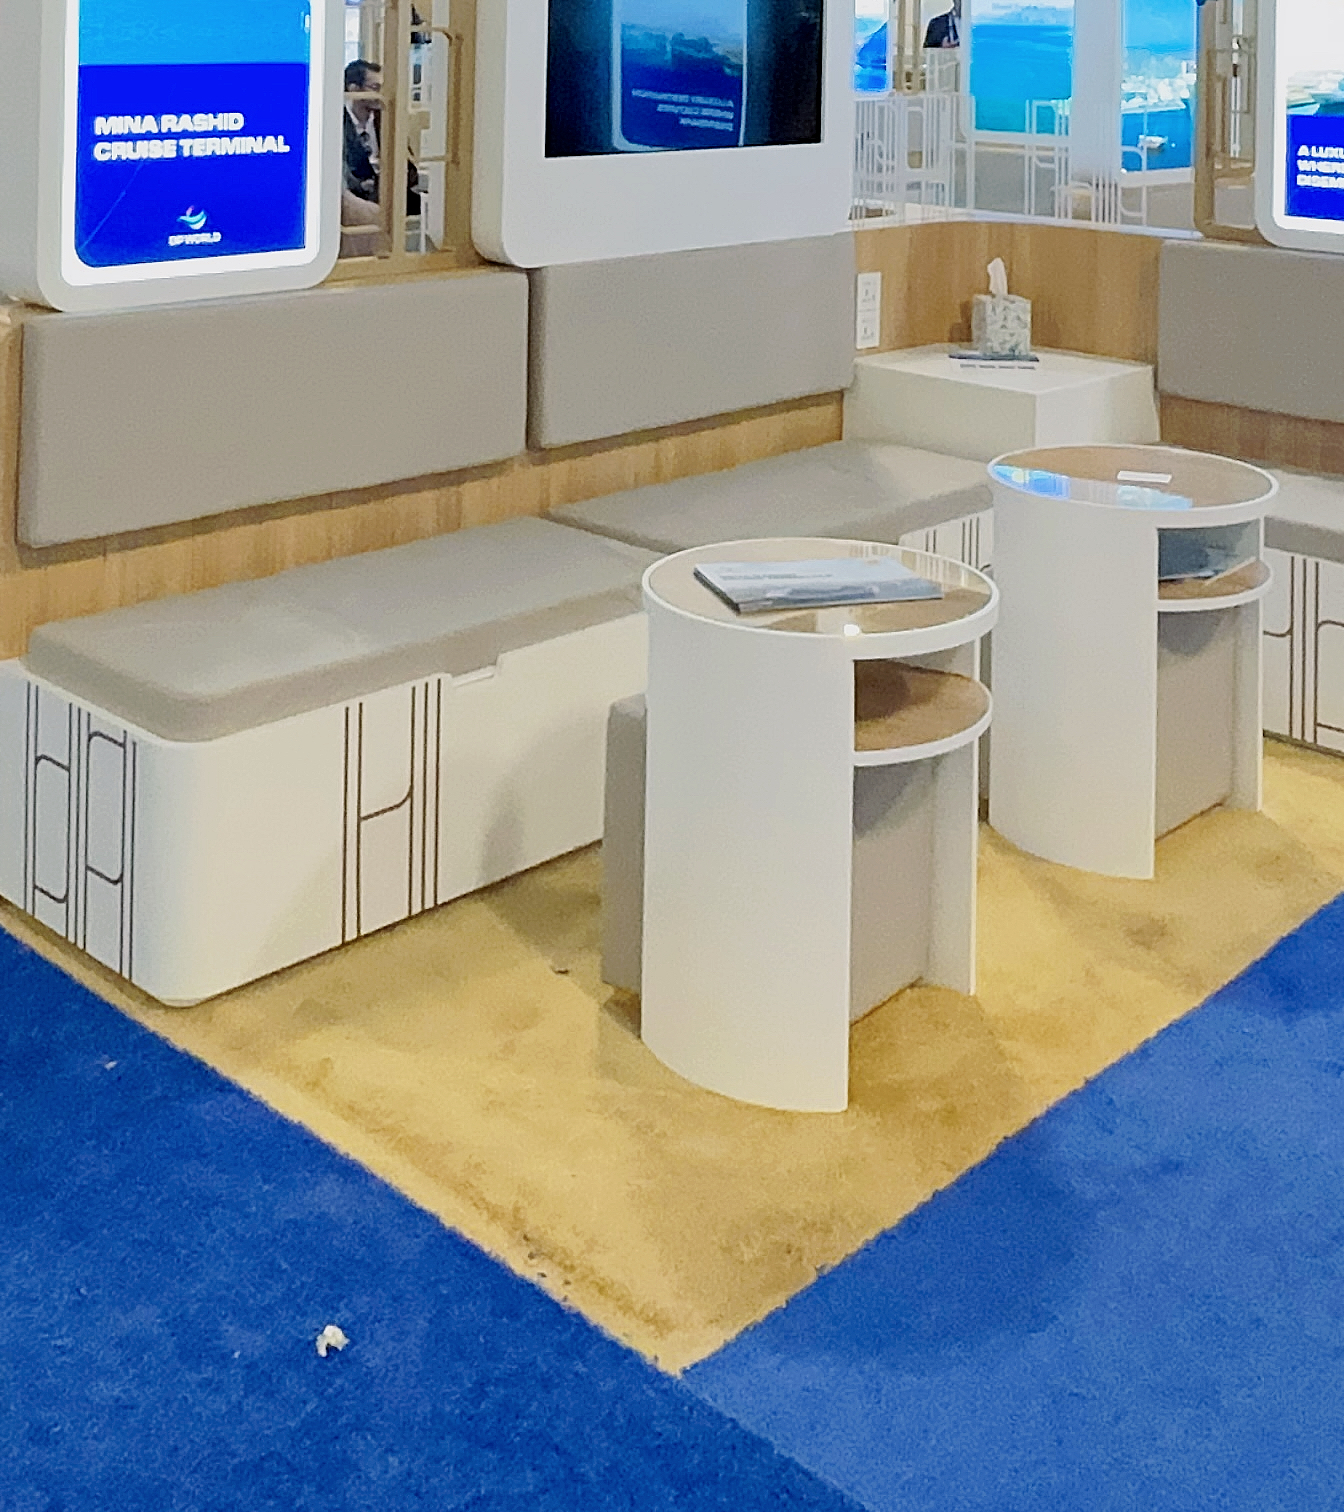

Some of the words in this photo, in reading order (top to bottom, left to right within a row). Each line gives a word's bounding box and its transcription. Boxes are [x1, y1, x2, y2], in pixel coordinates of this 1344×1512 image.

[94, 114, 158, 136] MINA
[160, 112, 244, 133] RASHID
[93, 139, 177, 161] CRUISE
[179, 135, 290, 157] TERMINAL
[1297, 145, 1310, 157] A
